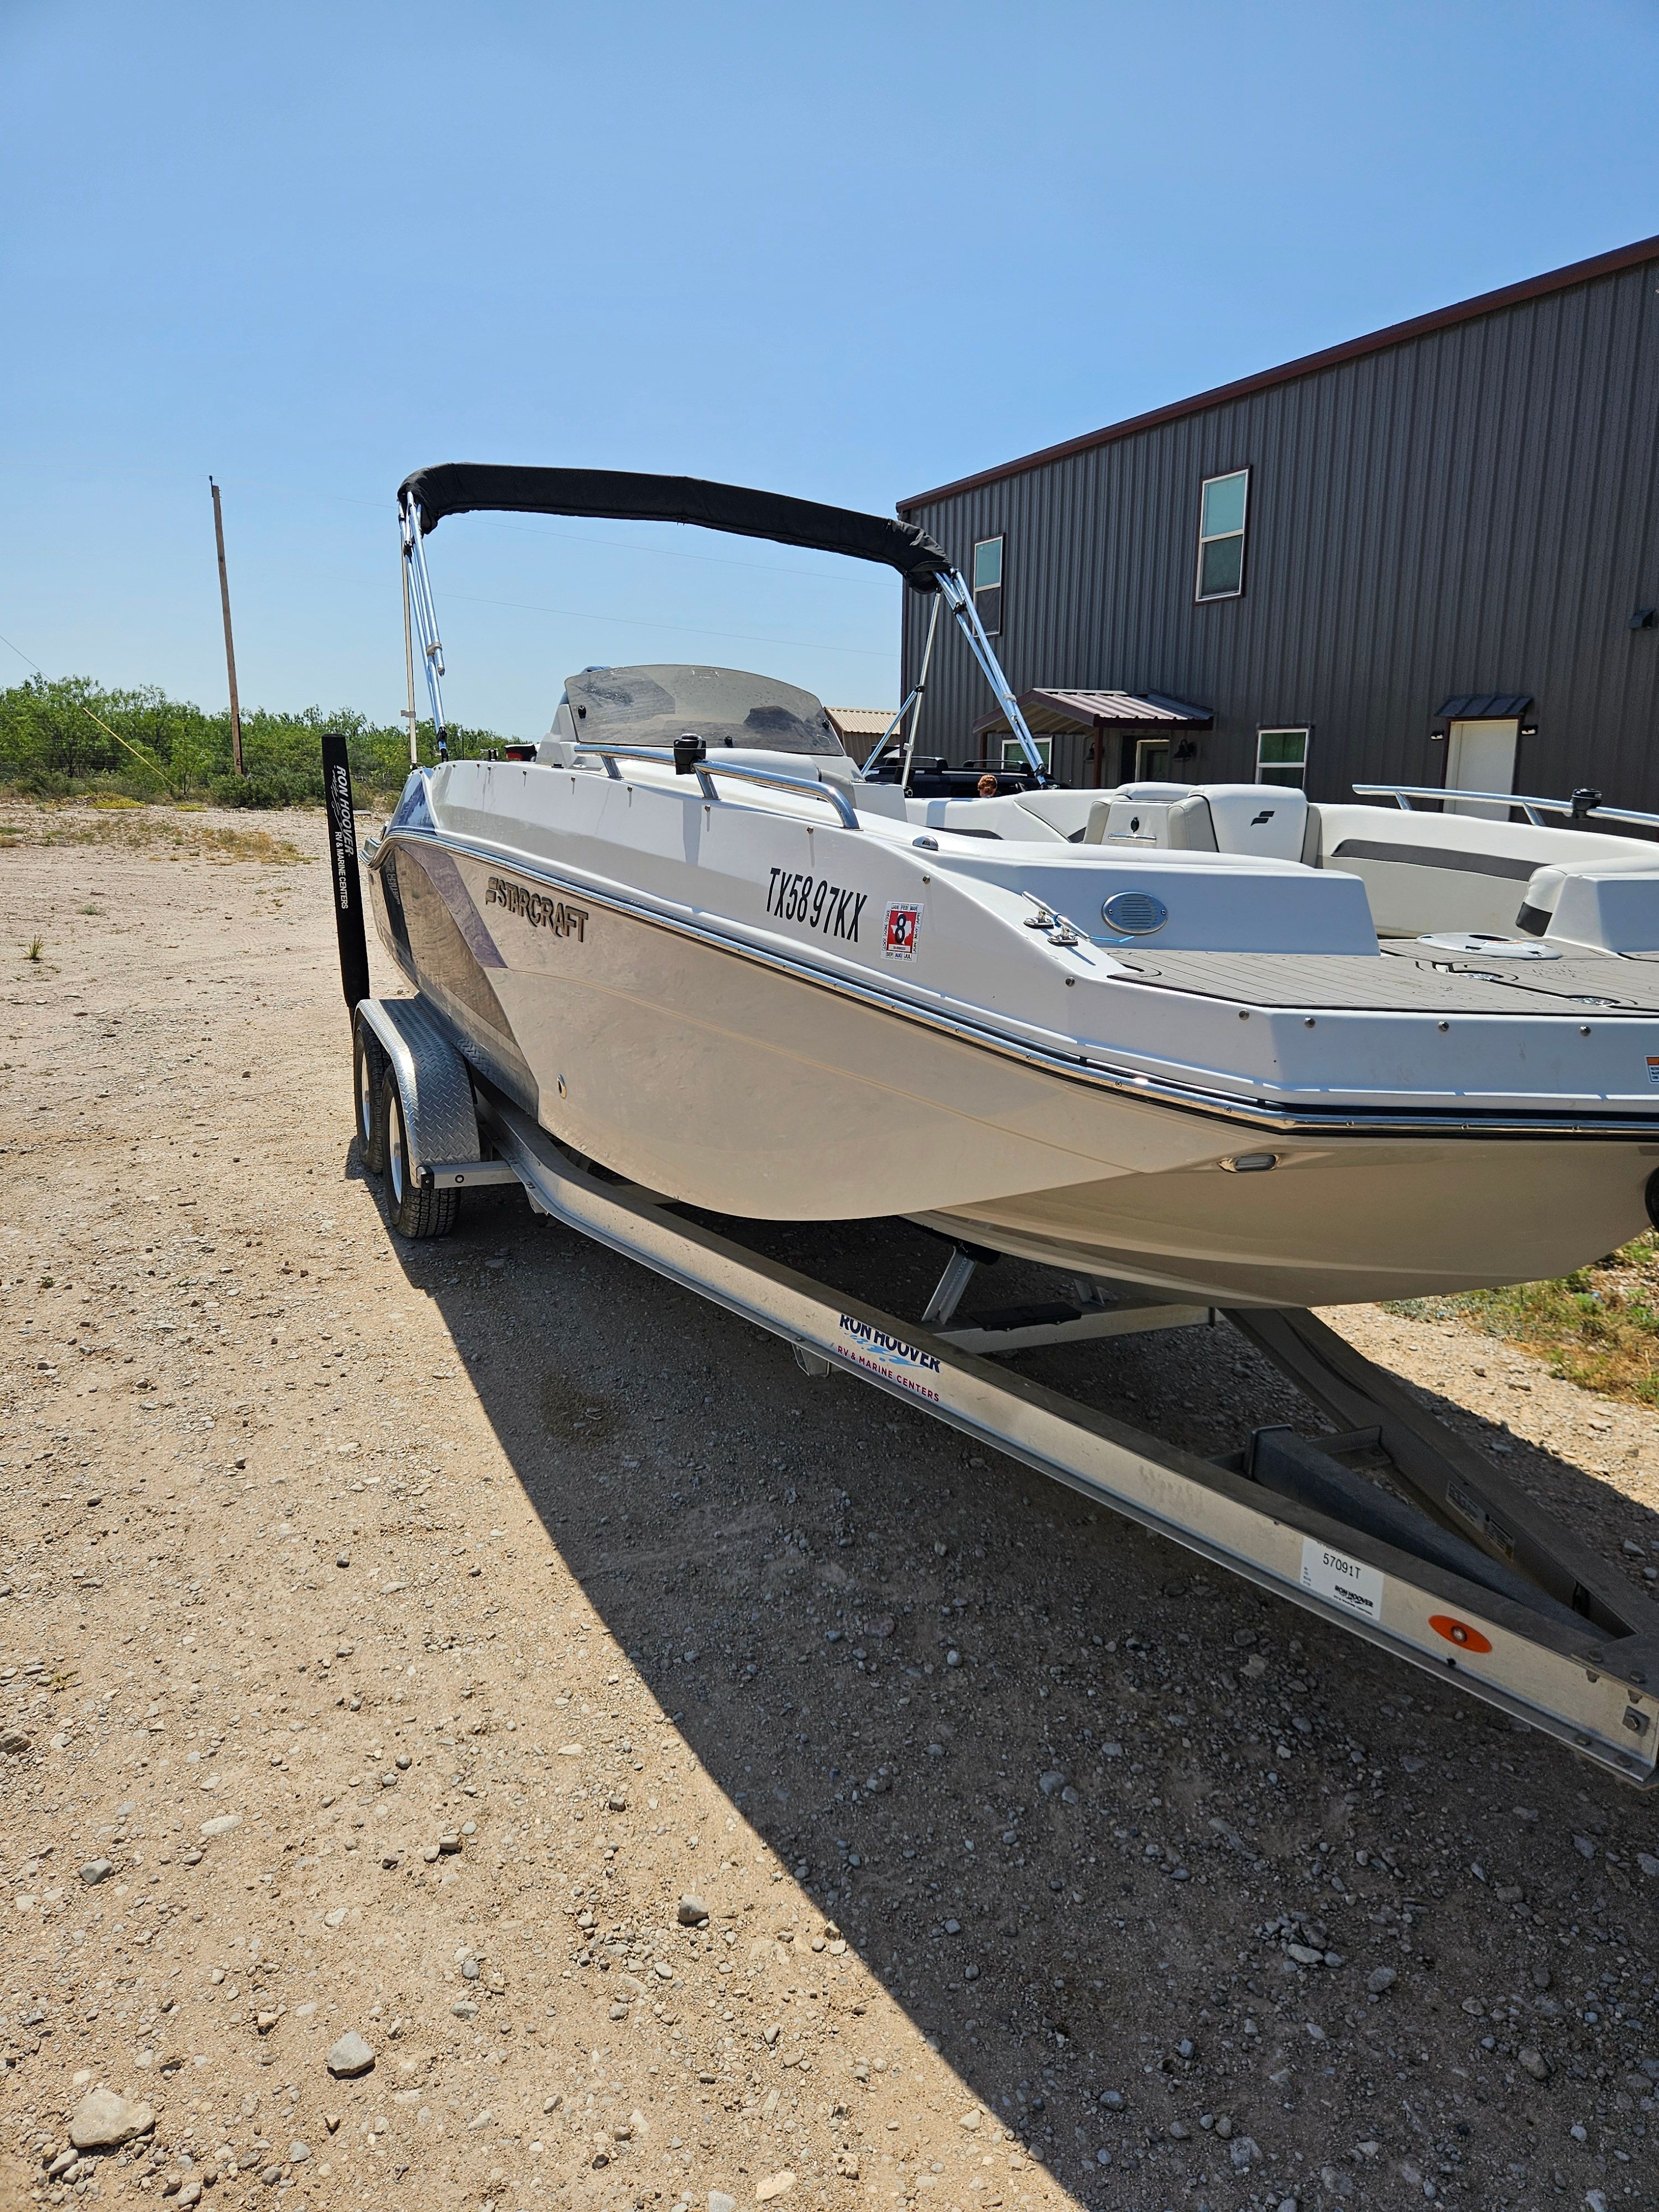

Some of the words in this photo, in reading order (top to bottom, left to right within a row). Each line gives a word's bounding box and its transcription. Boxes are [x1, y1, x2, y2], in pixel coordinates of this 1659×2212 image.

[336, 765, 348, 797] RON
[335, 832, 342, 842] RV
[340, 798, 354, 855] HOOVER
[336, 849, 346, 876] MARINE
[338, 877, 348, 909] CENTERS
[766, 867, 868, 942] TX5897KX
[496, 879, 589, 942] STARCRAFT
[895, 914, 906, 943] 8
[839, 1314, 872, 1340] RON
[874, 1330, 941, 1373] HOOVER
[838, 1345, 848, 1357] RV
[851, 1352, 855, 1360] &
[859, 1356, 893, 1379] MARINE
[896, 1375, 939, 1401] CENTERS
[1323, 1552, 1361, 1579] 57091T
